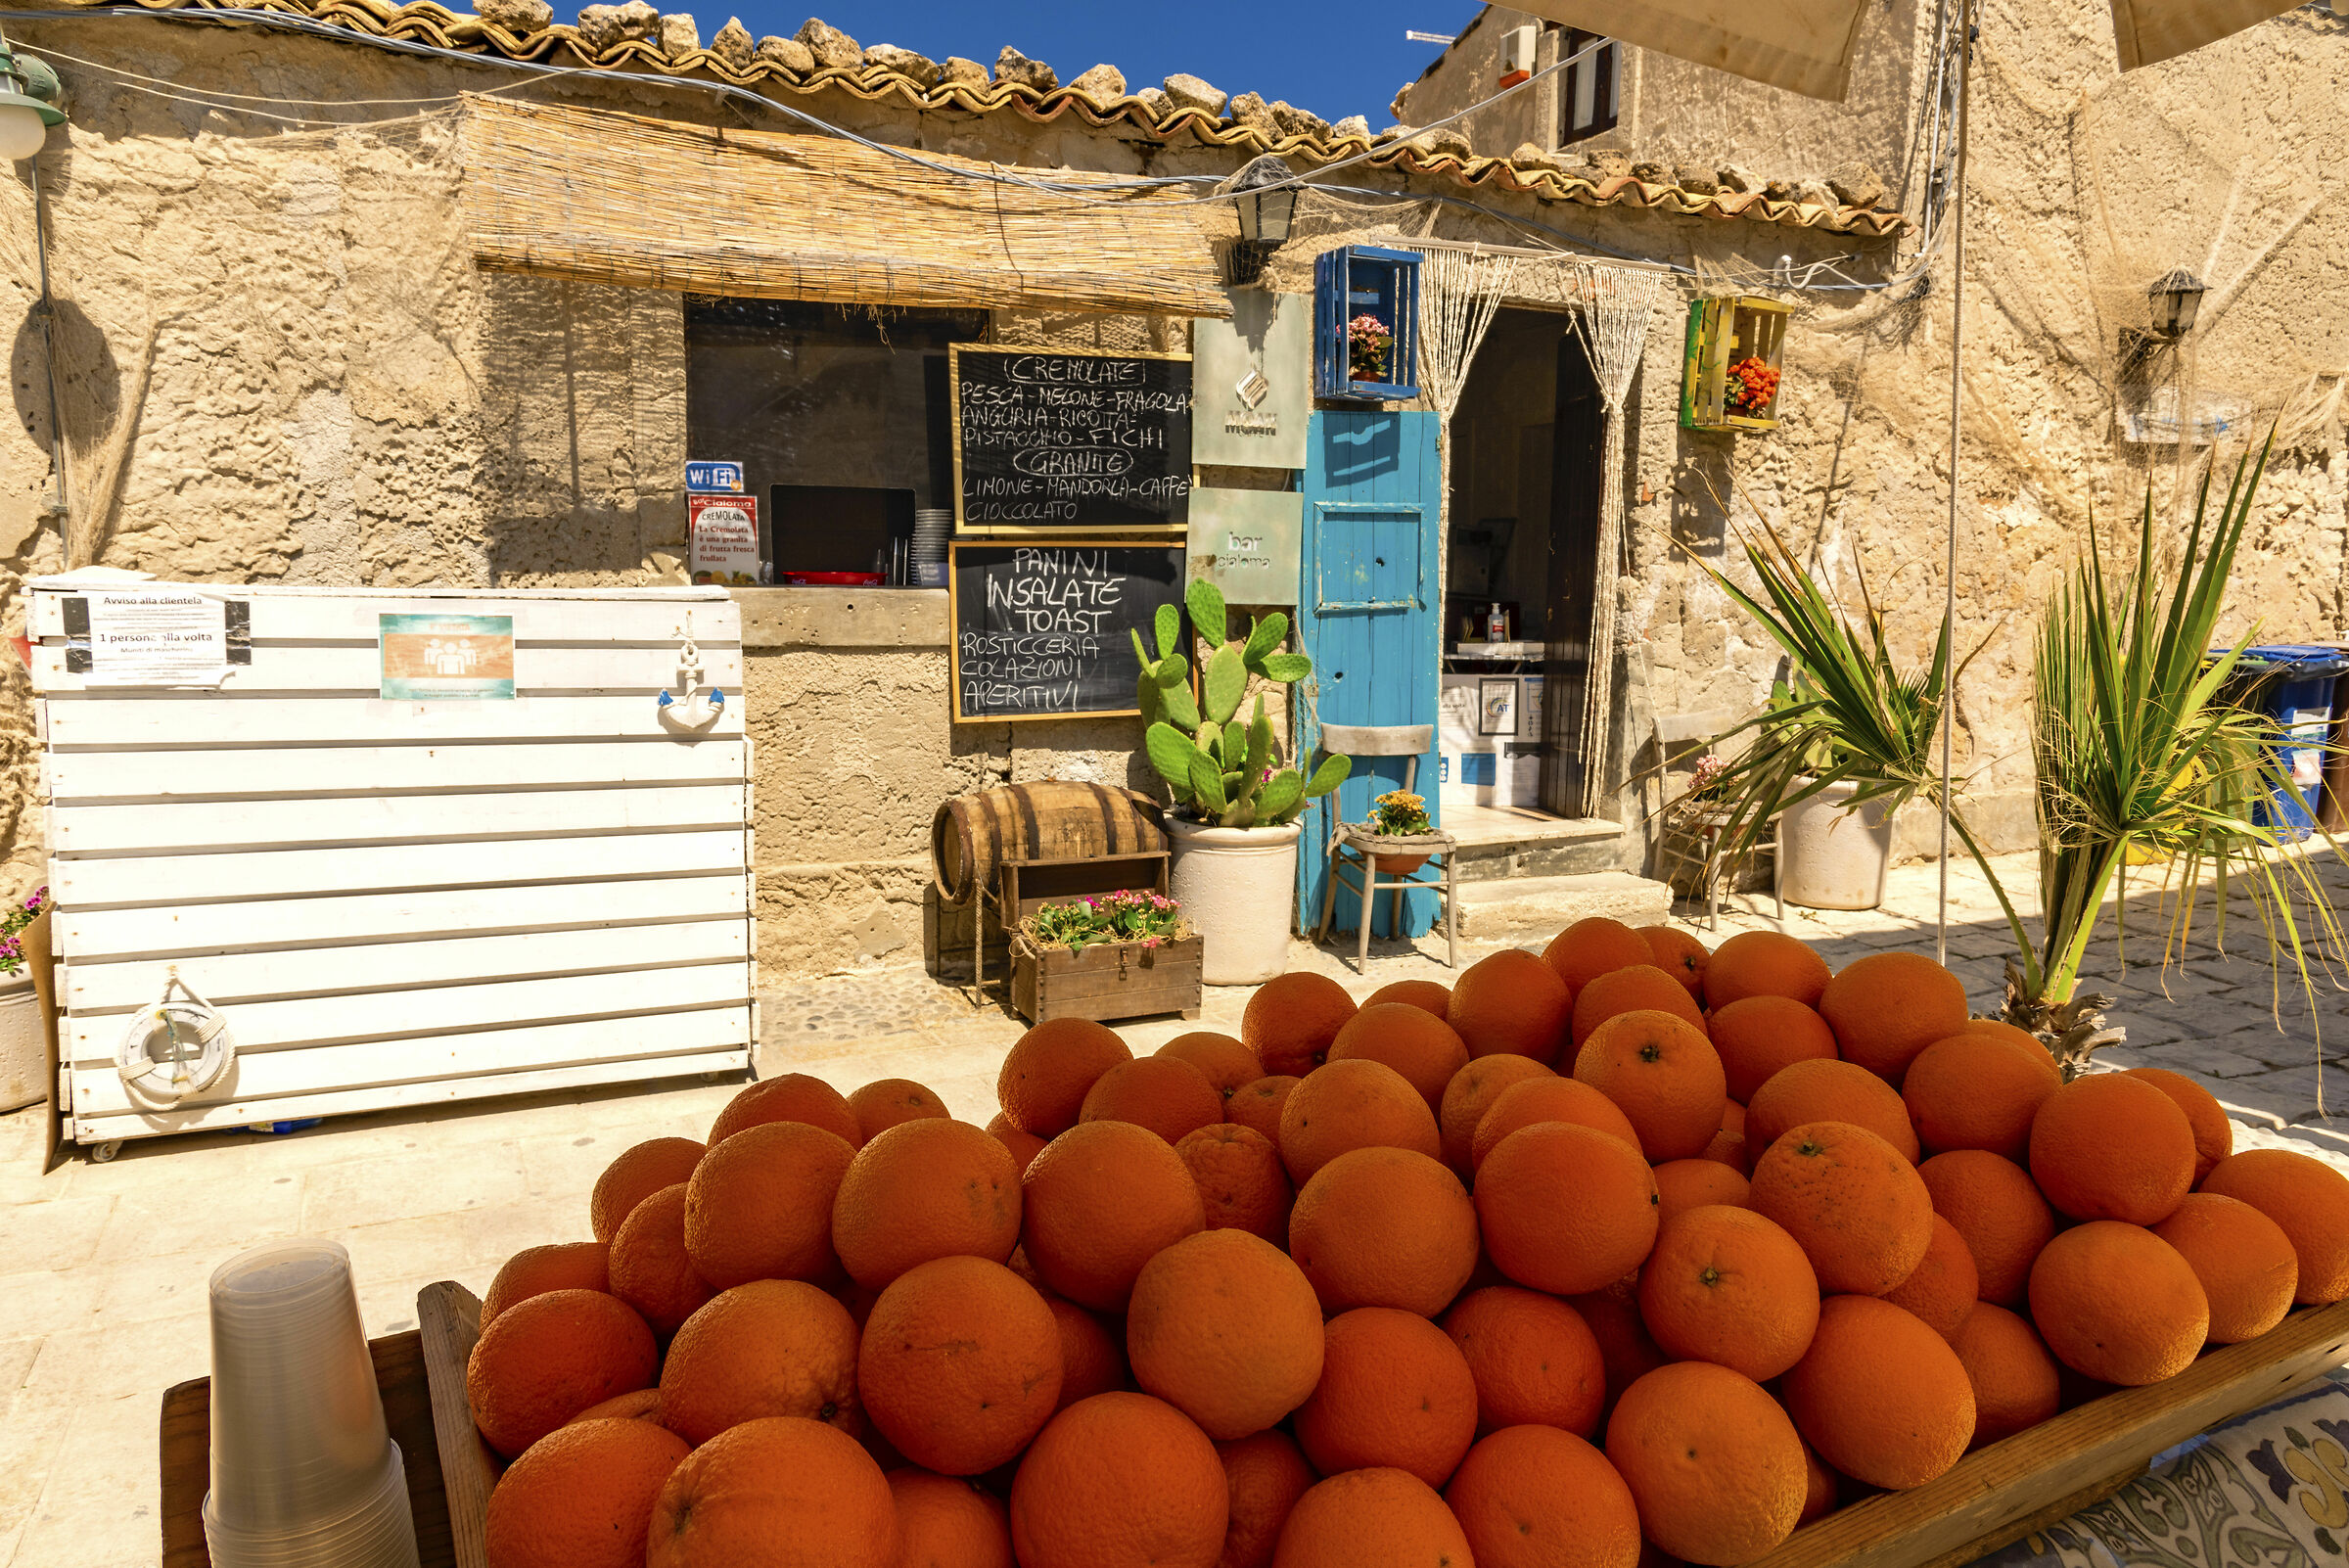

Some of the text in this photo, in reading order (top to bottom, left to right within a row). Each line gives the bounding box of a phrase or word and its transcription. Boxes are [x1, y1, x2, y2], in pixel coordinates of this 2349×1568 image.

[1012, 356, 1141, 384] CREMOLATE
[961, 381, 1024, 405] PESCA
[1089, 427, 1163, 449] FICHI
[1030, 450, 1123, 475] GRANITE
[702, 510, 746, 522] CREMOLATA
[965, 500, 1078, 522] CIOCCOLATO
[722, 535, 749, 544] granita
[733, 545, 756, 554] fresca
[1227, 530, 1264, 552] bar
[1012, 548, 1108, 578] PANINI
[1217, 553, 1271, 570] cialoma
[104, 596, 203, 605] Avviso alla clientela
[987, 574, 1127, 610] INSALATE
[1014, 608, 1113, 634] TOAST
[99, 633, 106, 642] 1
[183, 632, 213, 642] volta
[961, 631, 1100, 660] ROSTICCERIA
[960, 656, 1082, 681] COLAZIONI
[963, 680, 1079, 713] APERITIVI
